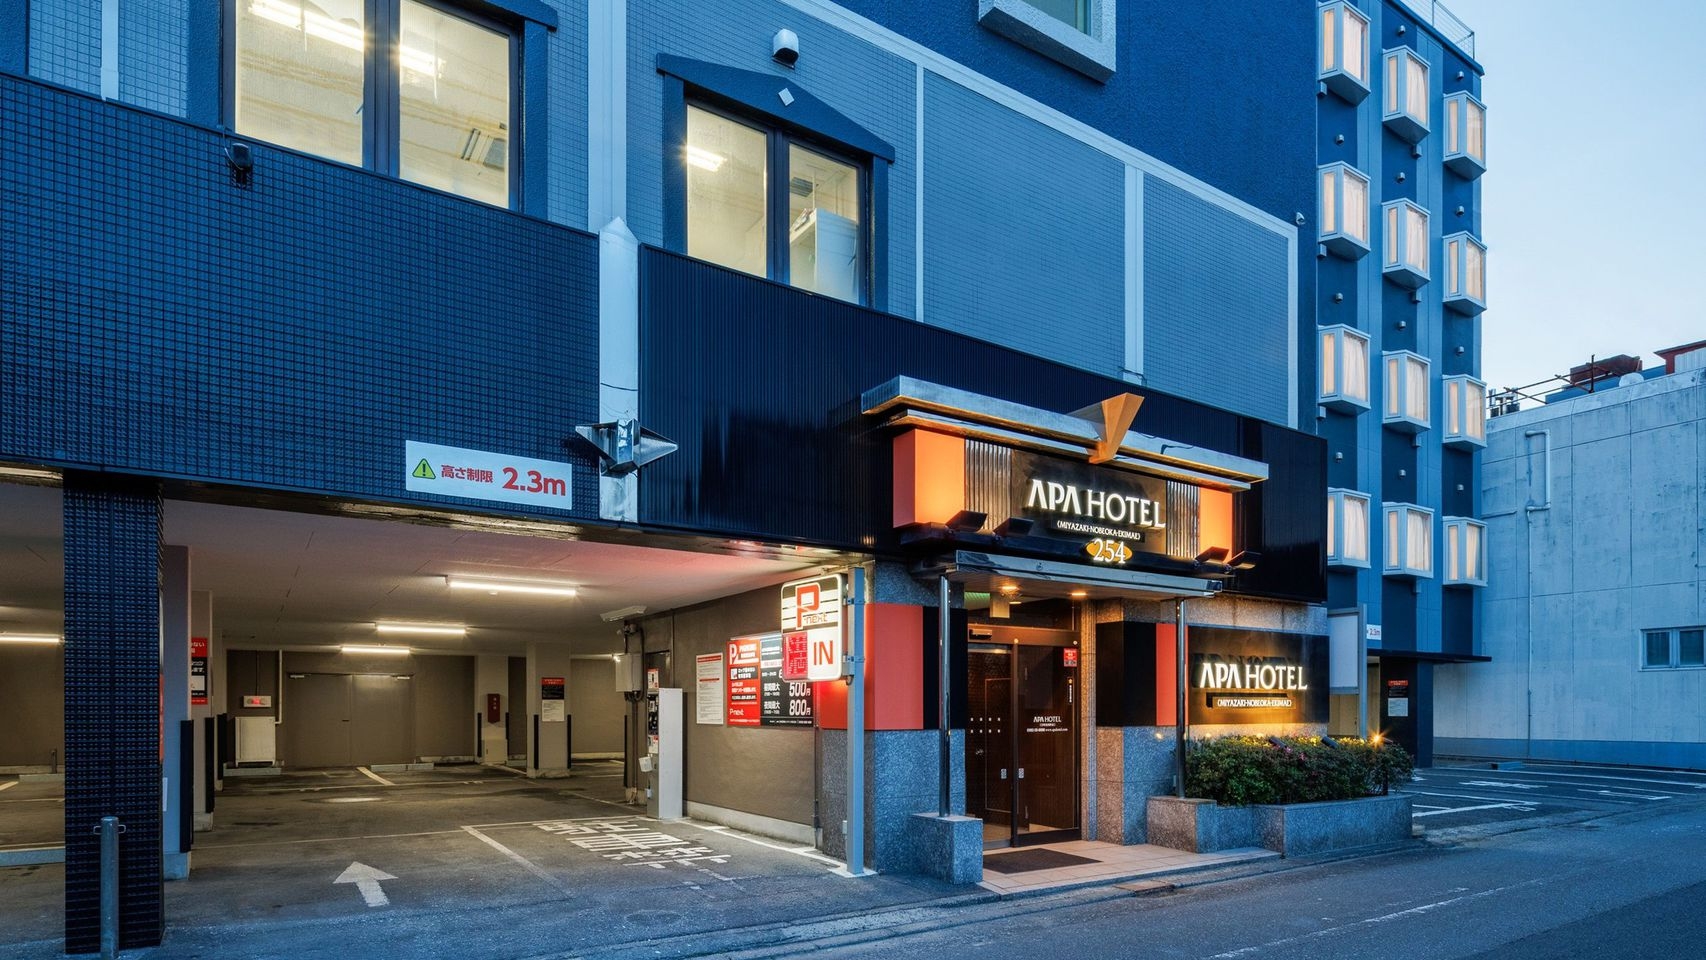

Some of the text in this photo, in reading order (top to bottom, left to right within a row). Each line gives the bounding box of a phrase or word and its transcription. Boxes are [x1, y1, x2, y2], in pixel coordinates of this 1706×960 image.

[441, 464, 566, 496] 高さ制限 2.3m
[1028, 479, 1166, 528] APA HOTEL
[1093, 538, 1126, 564] 254
[813, 640, 834, 666] IN
[1200, 662, 1308, 690] APA HOTEL
